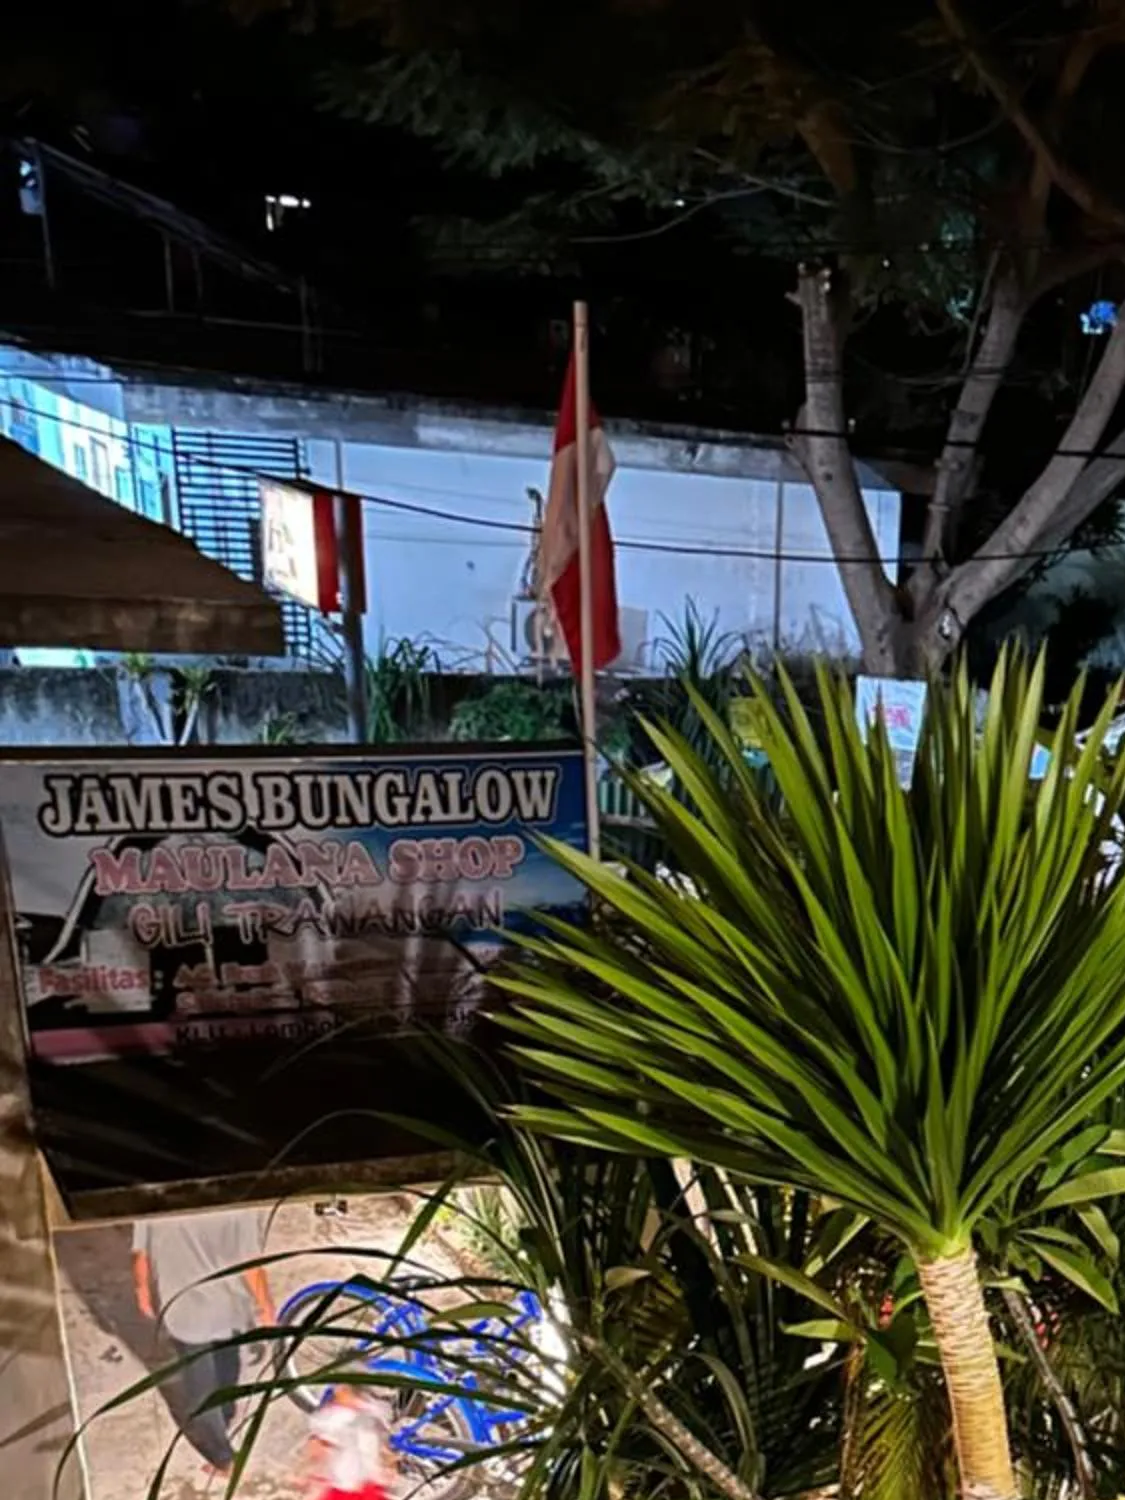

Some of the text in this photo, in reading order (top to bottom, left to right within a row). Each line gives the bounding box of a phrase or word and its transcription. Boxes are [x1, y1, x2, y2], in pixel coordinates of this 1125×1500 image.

[38, 768, 558, 837] JAMES BUNGALOW
[90, 837, 525, 895] MAULANA SHOP
[129, 888, 504, 946] GILI TRAWANGAN
[39, 964, 149, 992] Fasilitas
